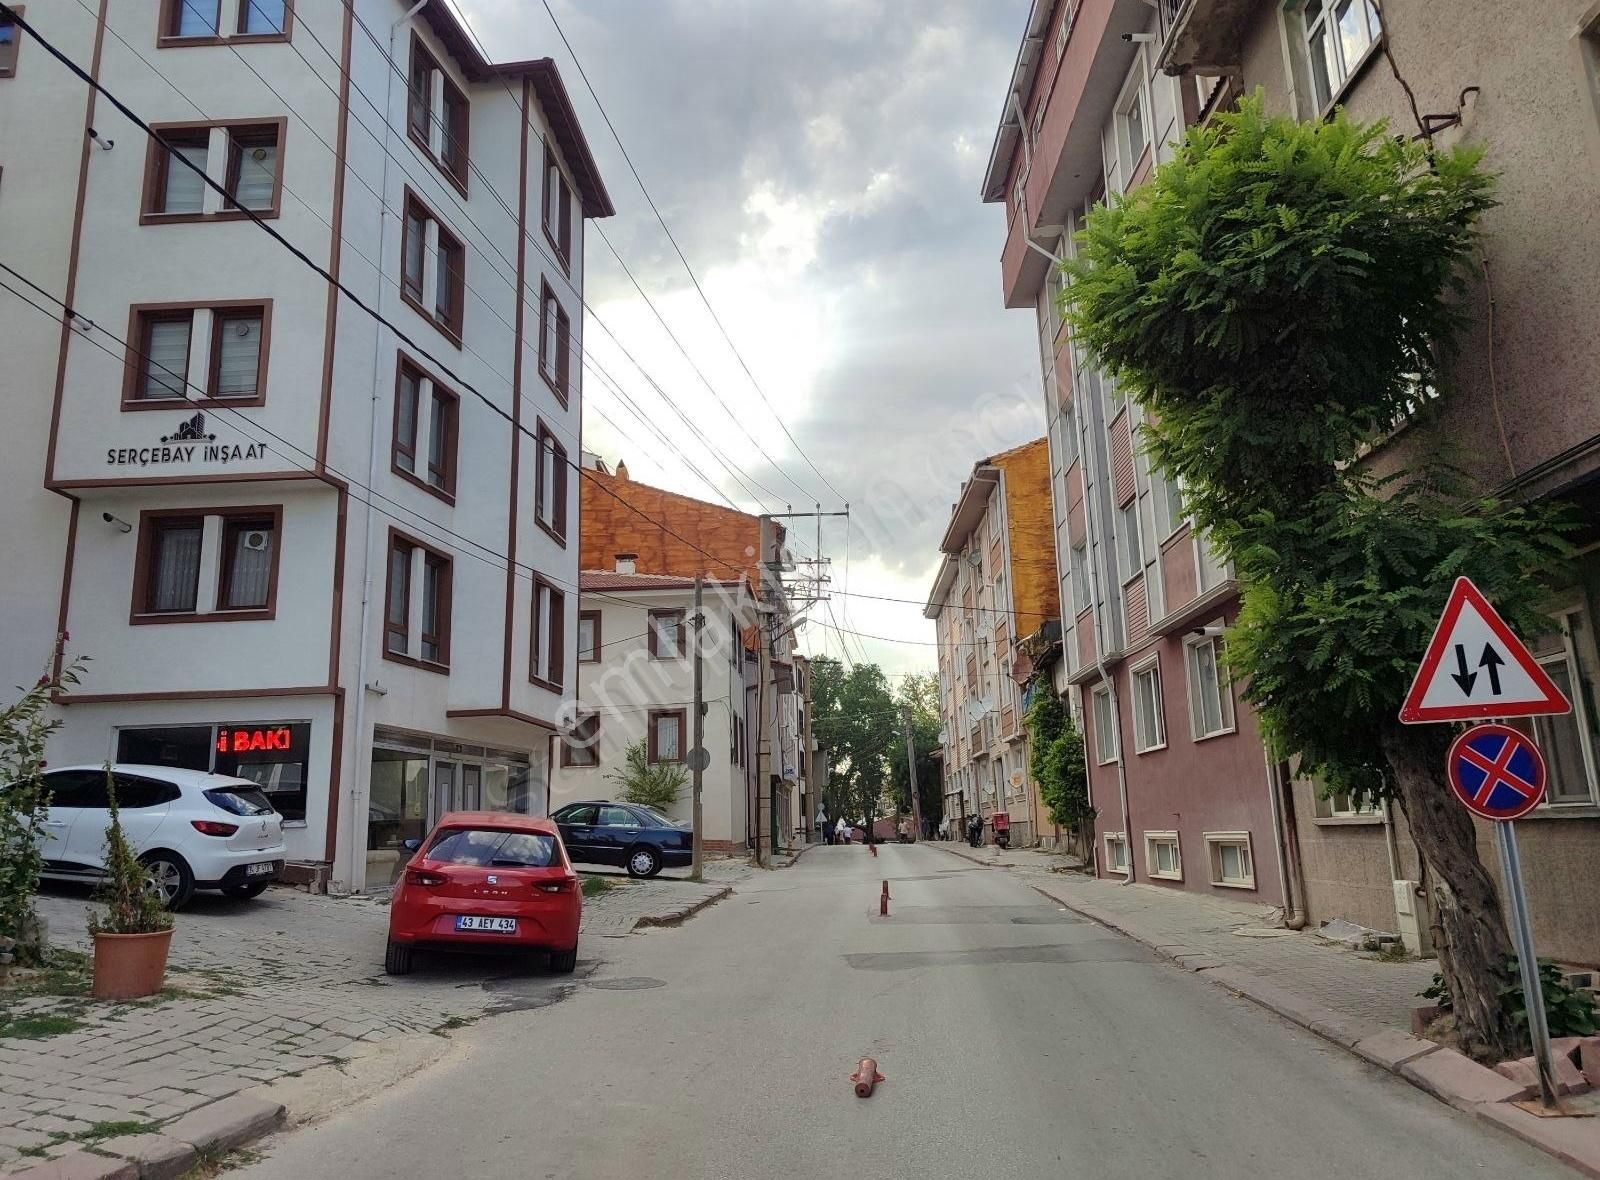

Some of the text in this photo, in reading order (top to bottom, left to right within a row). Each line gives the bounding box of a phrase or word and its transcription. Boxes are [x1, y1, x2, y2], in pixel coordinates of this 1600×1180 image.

[107, 443, 267, 466] SERÇEBAY İNŞAAT
[462, 917, 514, 930] 43 AEY 434
